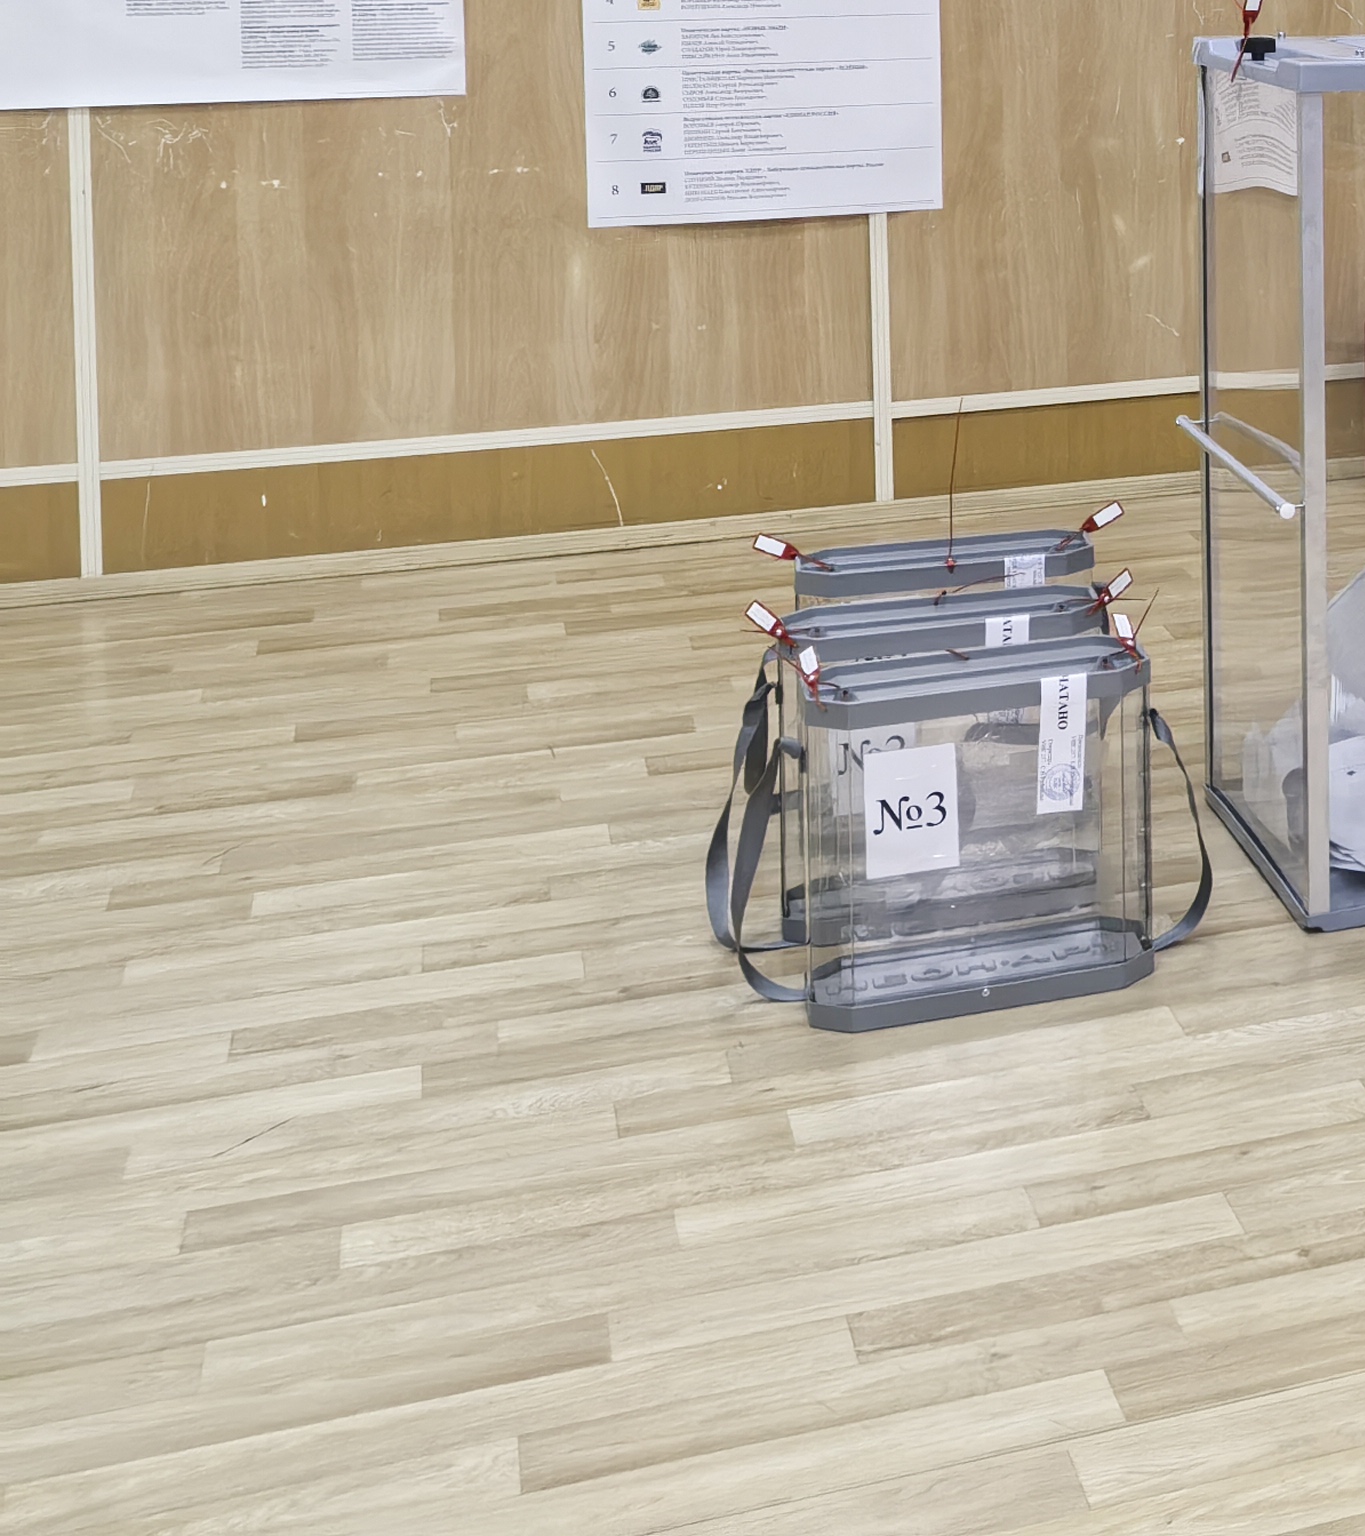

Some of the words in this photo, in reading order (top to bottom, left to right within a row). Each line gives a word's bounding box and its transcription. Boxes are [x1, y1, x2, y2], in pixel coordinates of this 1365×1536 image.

[606, 40, 616, 52] 5
[608, 87, 617, 99] 6
[609, 133, 618, 145] 7
[611, 183, 620, 196] 8
